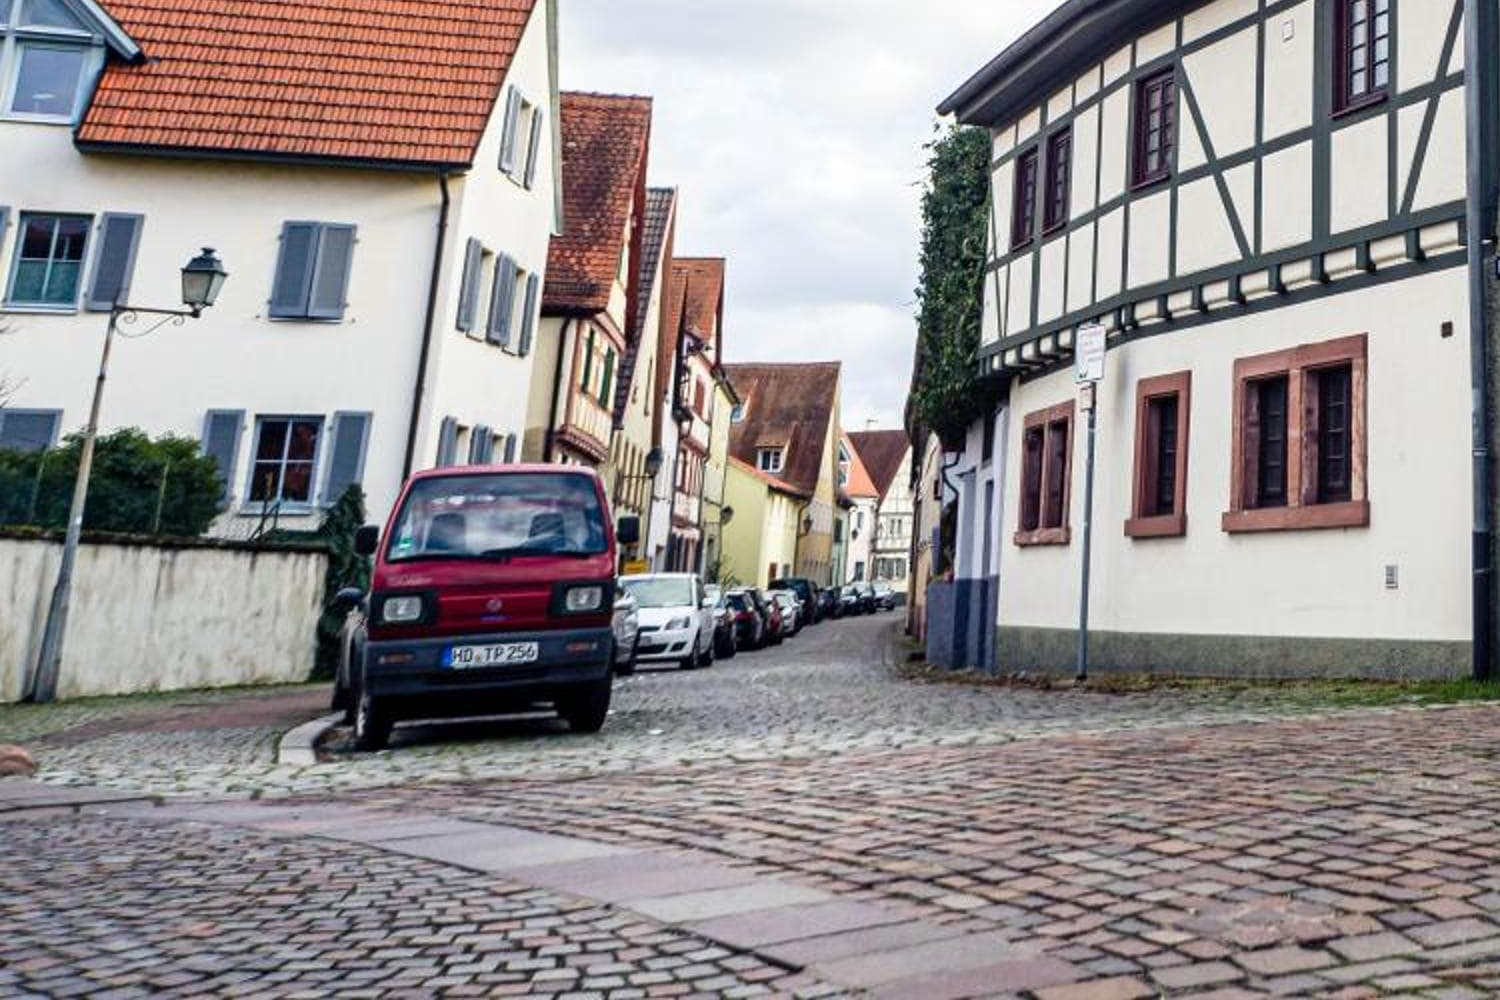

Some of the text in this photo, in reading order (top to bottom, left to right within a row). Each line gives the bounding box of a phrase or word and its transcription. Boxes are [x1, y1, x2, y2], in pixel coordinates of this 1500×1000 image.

[453, 645, 535, 662] HD TP 256
